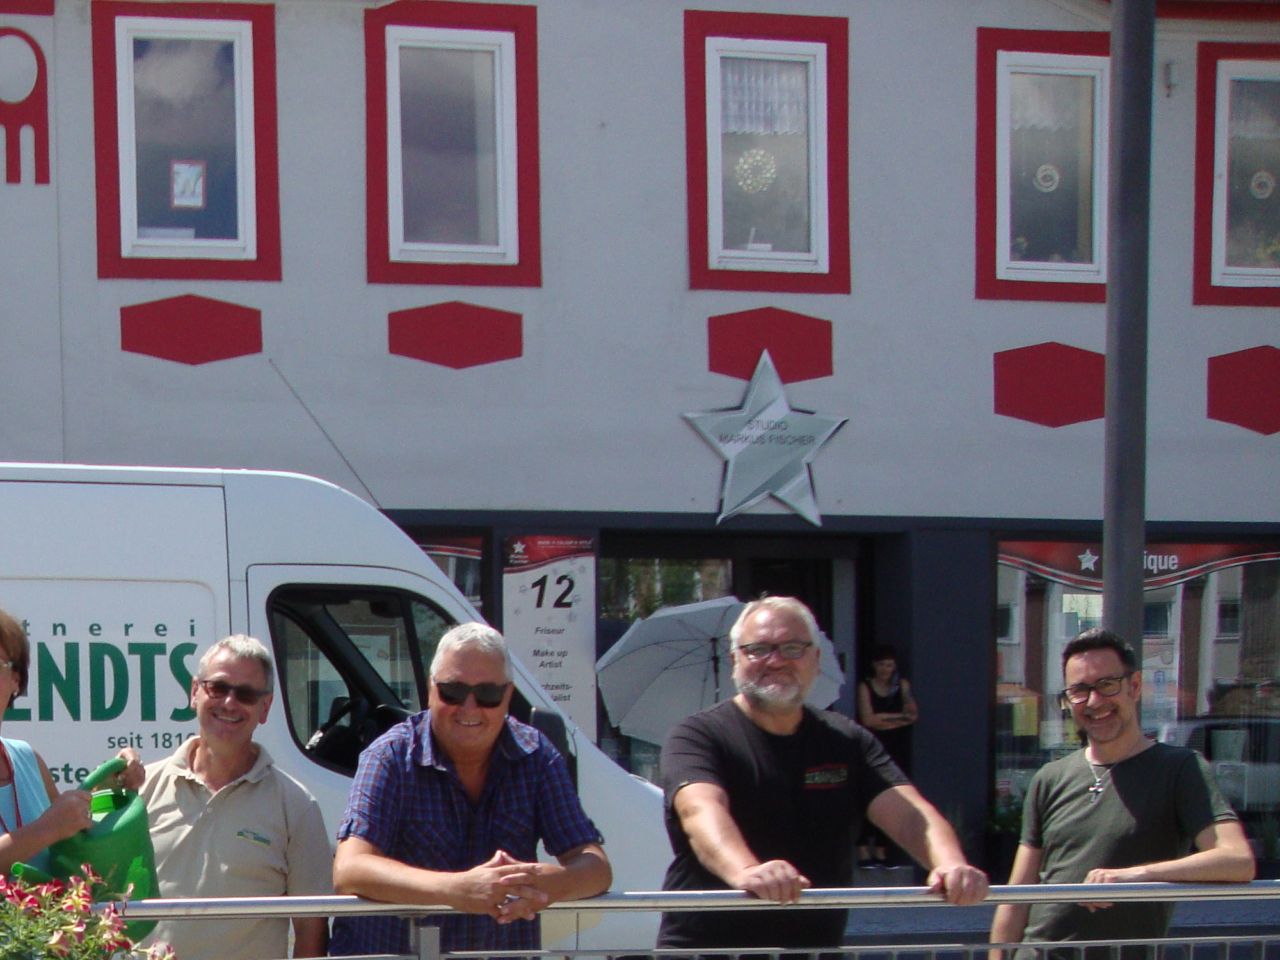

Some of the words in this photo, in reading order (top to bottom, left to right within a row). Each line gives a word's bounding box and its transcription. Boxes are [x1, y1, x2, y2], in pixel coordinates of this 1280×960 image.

[746, 420, 789, 431] STUDIO
[718, 433, 766, 445] MARKUS
[769, 434, 816, 446] FISCHER
[1143, 550, 1179, 574] ique
[531, 574, 575, 608] 12
[534, 627, 566, 635] Friseur
[532, 649, 555, 658] Make
[556, 650, 569, 659] up
[538, 661, 563, 669] Artist
[107, 732, 143, 749] seit
